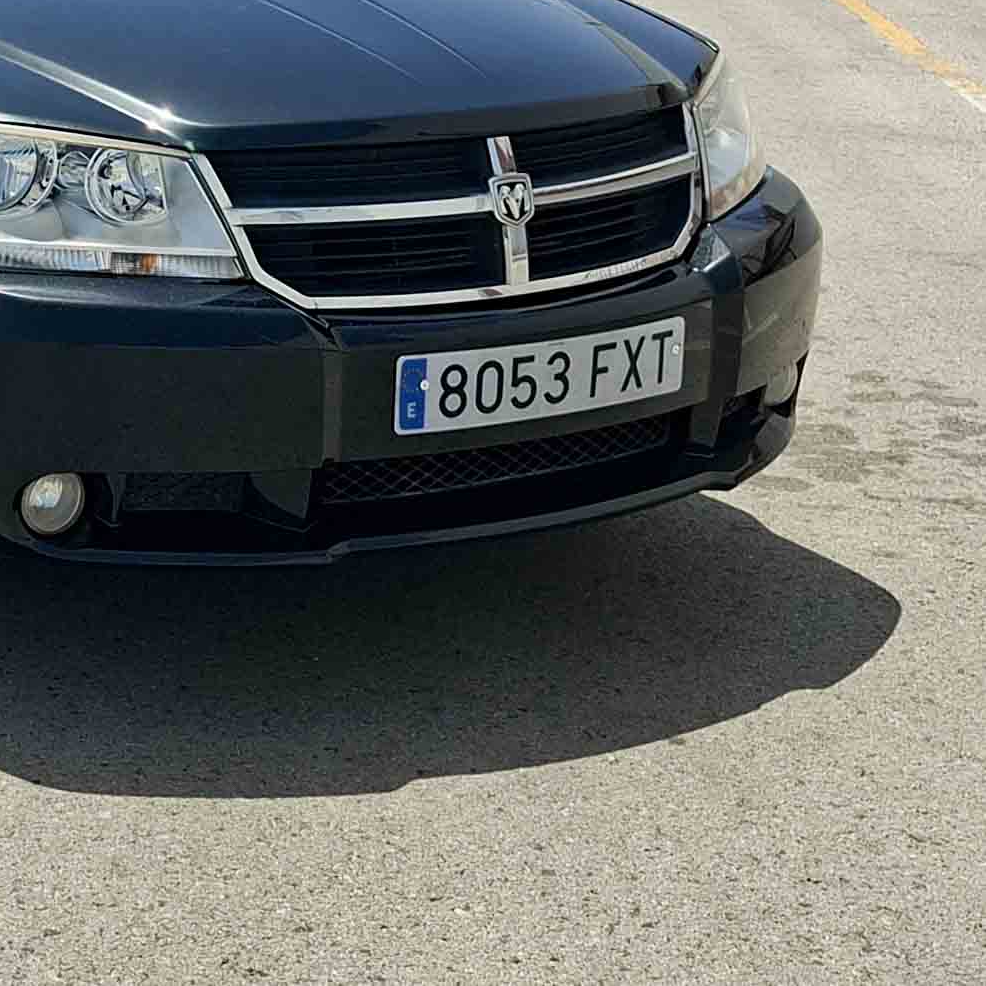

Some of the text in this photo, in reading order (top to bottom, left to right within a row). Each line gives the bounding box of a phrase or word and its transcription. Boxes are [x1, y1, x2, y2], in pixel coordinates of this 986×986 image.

[438, 329, 674, 419] 8053 FXT
[406, 402, 417, 419] E
